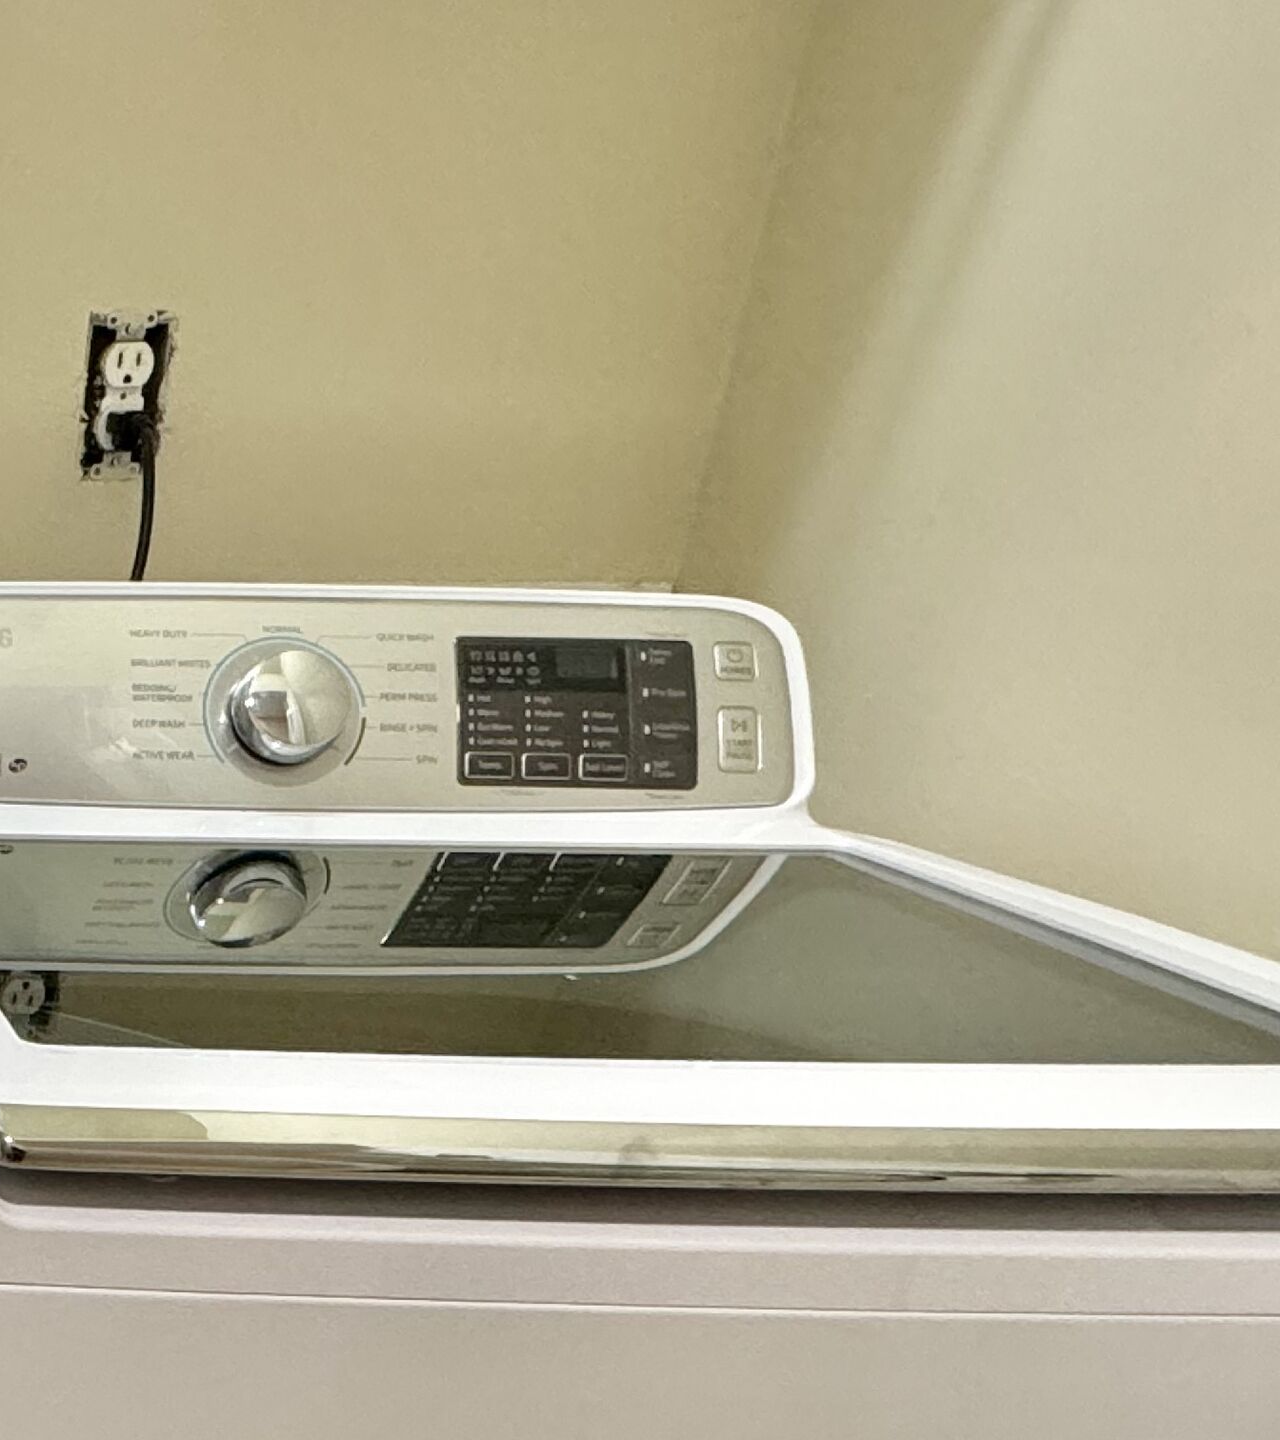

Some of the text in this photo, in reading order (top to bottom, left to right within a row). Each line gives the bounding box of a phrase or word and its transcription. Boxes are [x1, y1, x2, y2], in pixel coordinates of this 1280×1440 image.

[130, 629, 188, 638] HEAVY DUTY
[262, 625, 303, 634] NORMAL
[376, 633, 434, 642] QUICK WASH
[130, 658, 176, 667] BRILLIANT
[387, 662, 436, 672] DELICATES
[133, 694, 193, 702] WATERPROOF
[380, 692, 438, 702] PERM PRESS
[132, 719, 186, 728] DEEP WASH
[380, 723, 406, 732] RINSE
[416, 723, 438, 733] SPIN
[132, 751, 196, 760] ACTIVE WEAR
[415, 754, 438, 764] SPIN
